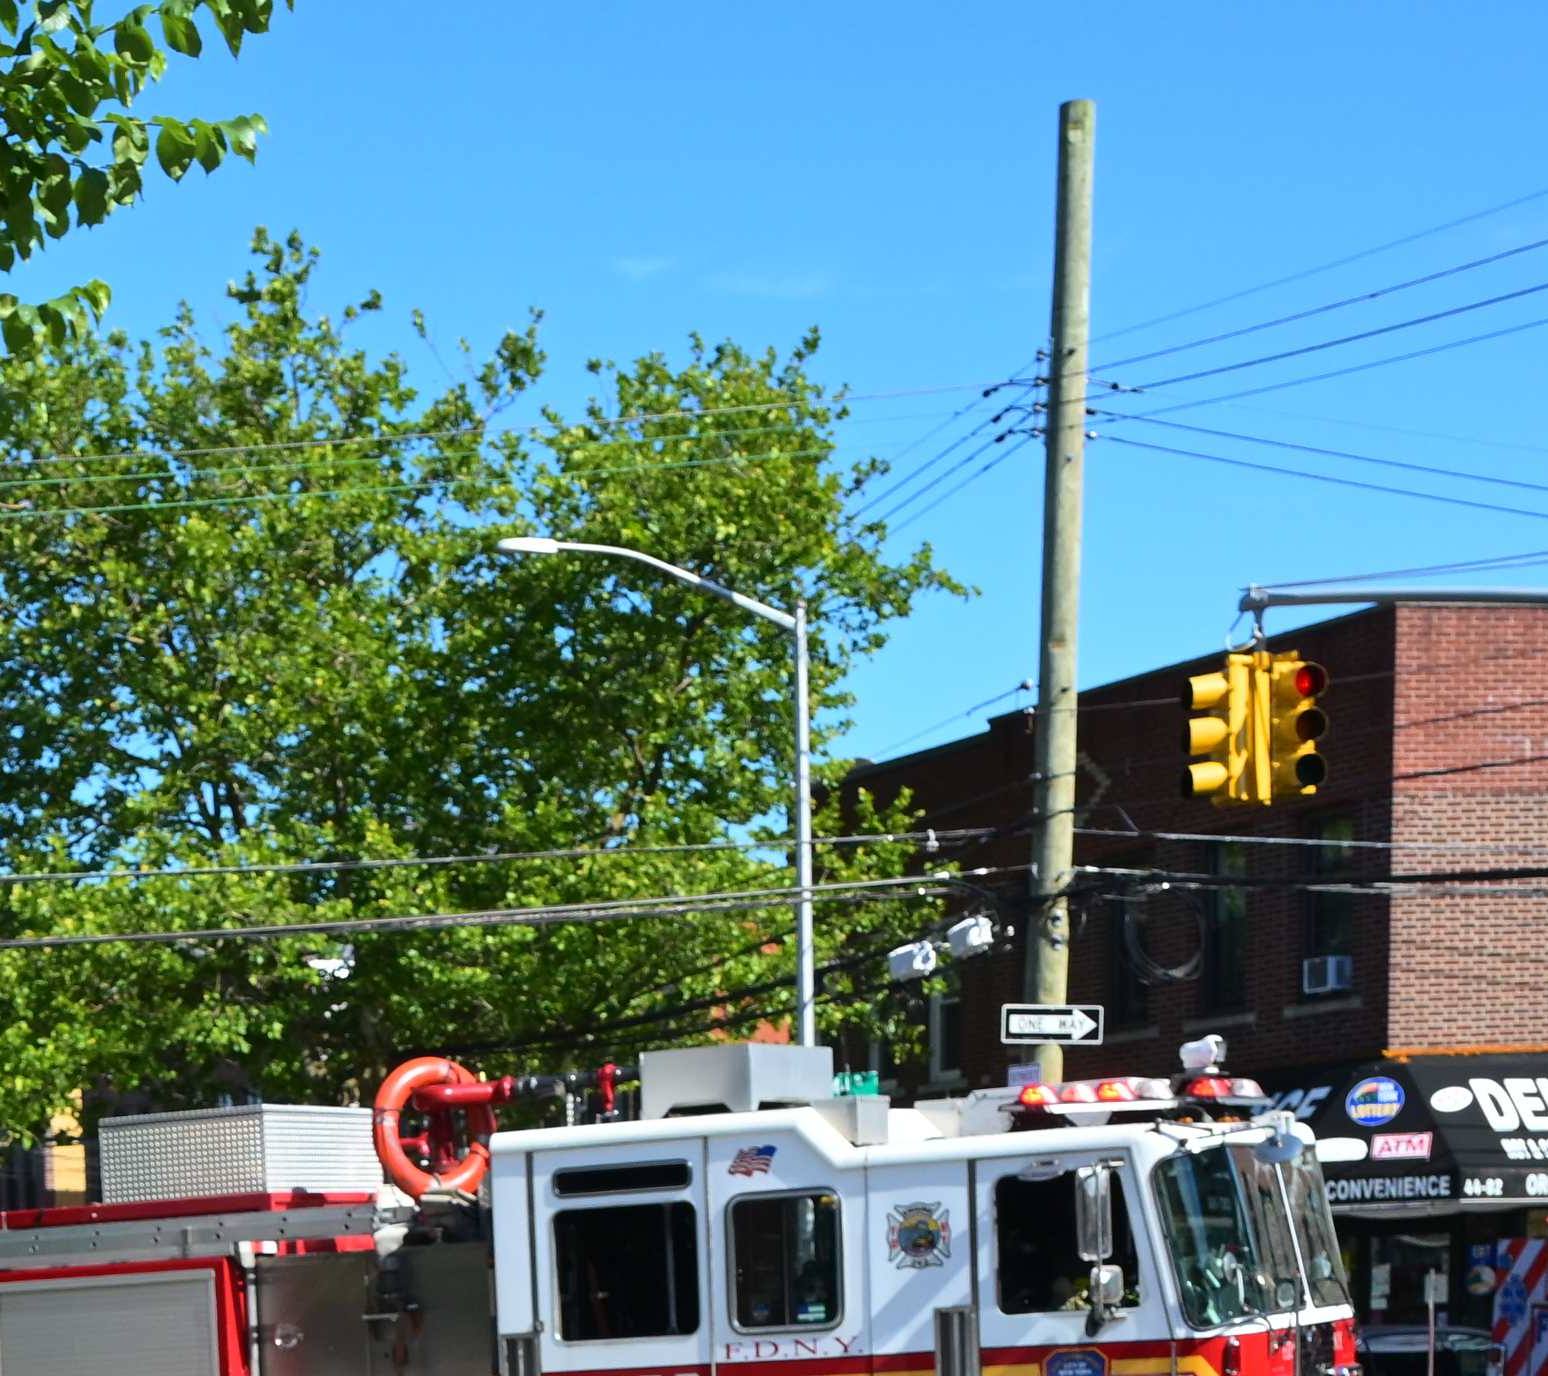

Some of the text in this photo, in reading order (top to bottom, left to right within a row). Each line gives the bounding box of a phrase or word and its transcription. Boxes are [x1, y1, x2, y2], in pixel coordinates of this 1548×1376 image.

[1059, 1018, 1085, 1030] WAY
[1377, 1137, 1425, 1155] ATM
[1325, 1175, 1451, 1201] CONVENIENCE
